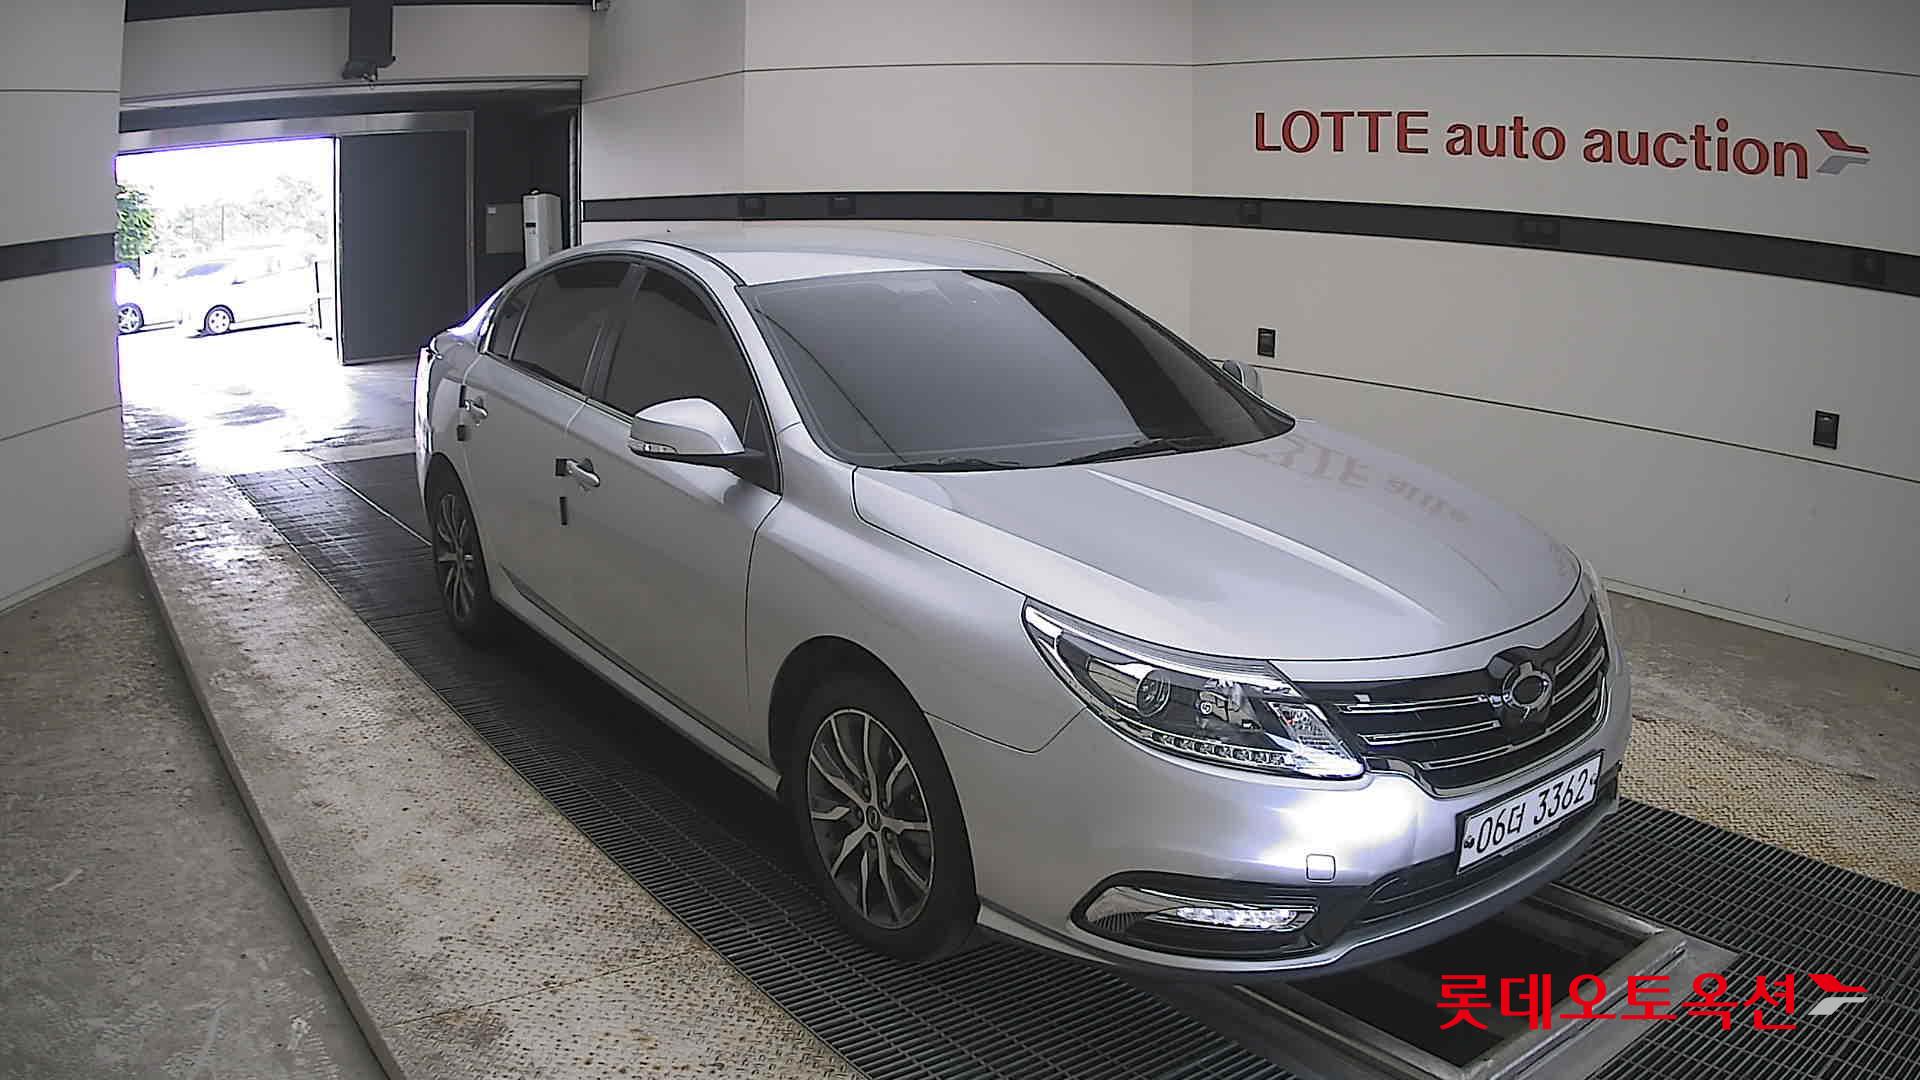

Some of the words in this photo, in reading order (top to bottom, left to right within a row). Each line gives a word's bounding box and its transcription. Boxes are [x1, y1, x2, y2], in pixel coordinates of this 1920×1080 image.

[1254, 110, 1430, 155] LOTTE
[1445, 115, 1568, 161] auto
[1583, 118, 1809, 179] auction
[1476, 802, 1526, 854] 06더
[1533, 768, 1589, 826] 3362
